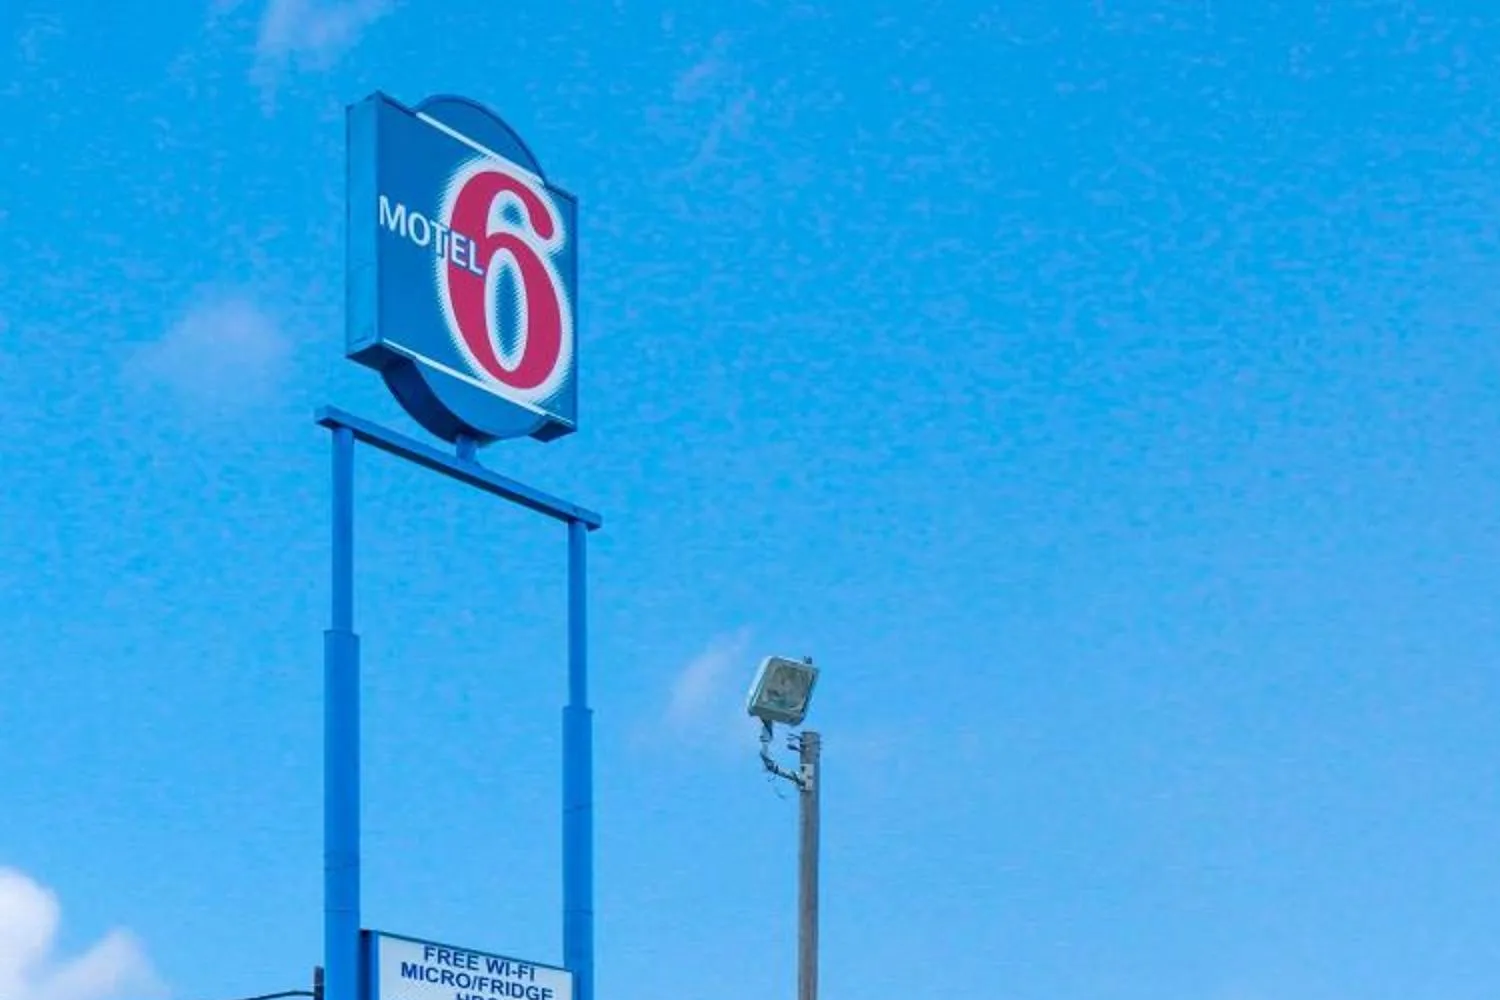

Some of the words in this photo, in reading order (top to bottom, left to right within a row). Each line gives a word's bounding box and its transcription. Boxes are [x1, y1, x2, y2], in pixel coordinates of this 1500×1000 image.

[379, 195, 484, 275] MOTEL
[441, 161, 568, 398] 6
[423, 946, 480, 971] FREE
[485, 957, 535, 982] WI-FI
